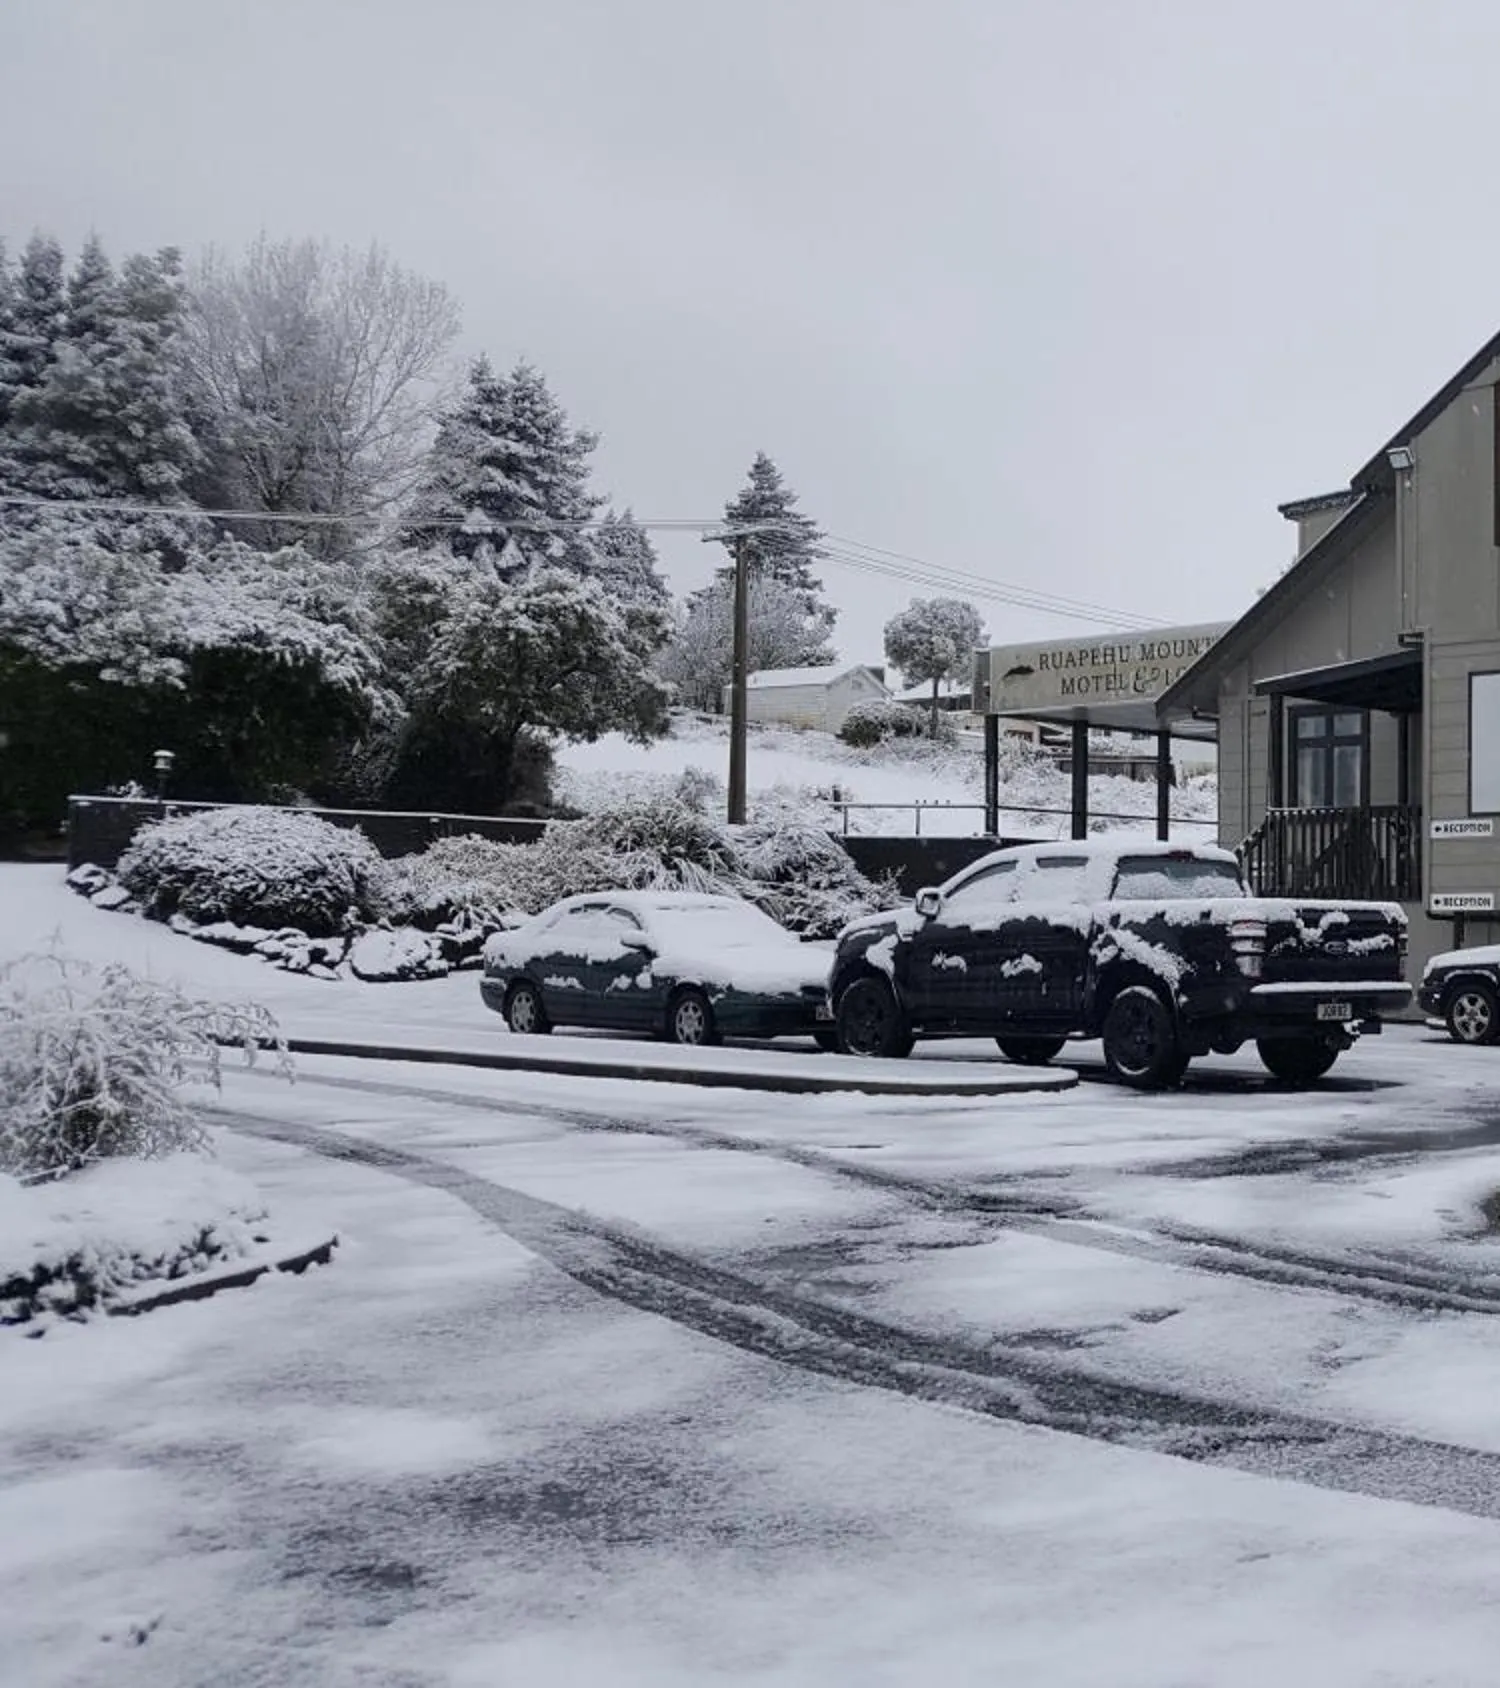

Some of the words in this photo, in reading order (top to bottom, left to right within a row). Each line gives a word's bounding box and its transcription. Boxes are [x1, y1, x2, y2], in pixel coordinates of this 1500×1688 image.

[1039, 646, 1131, 671] RUAPEHU
[1060, 673, 1130, 696] MOTEL
[1443, 823, 1491, 833] RECEPTION
[1443, 896, 1491, 907] RECEPTION
